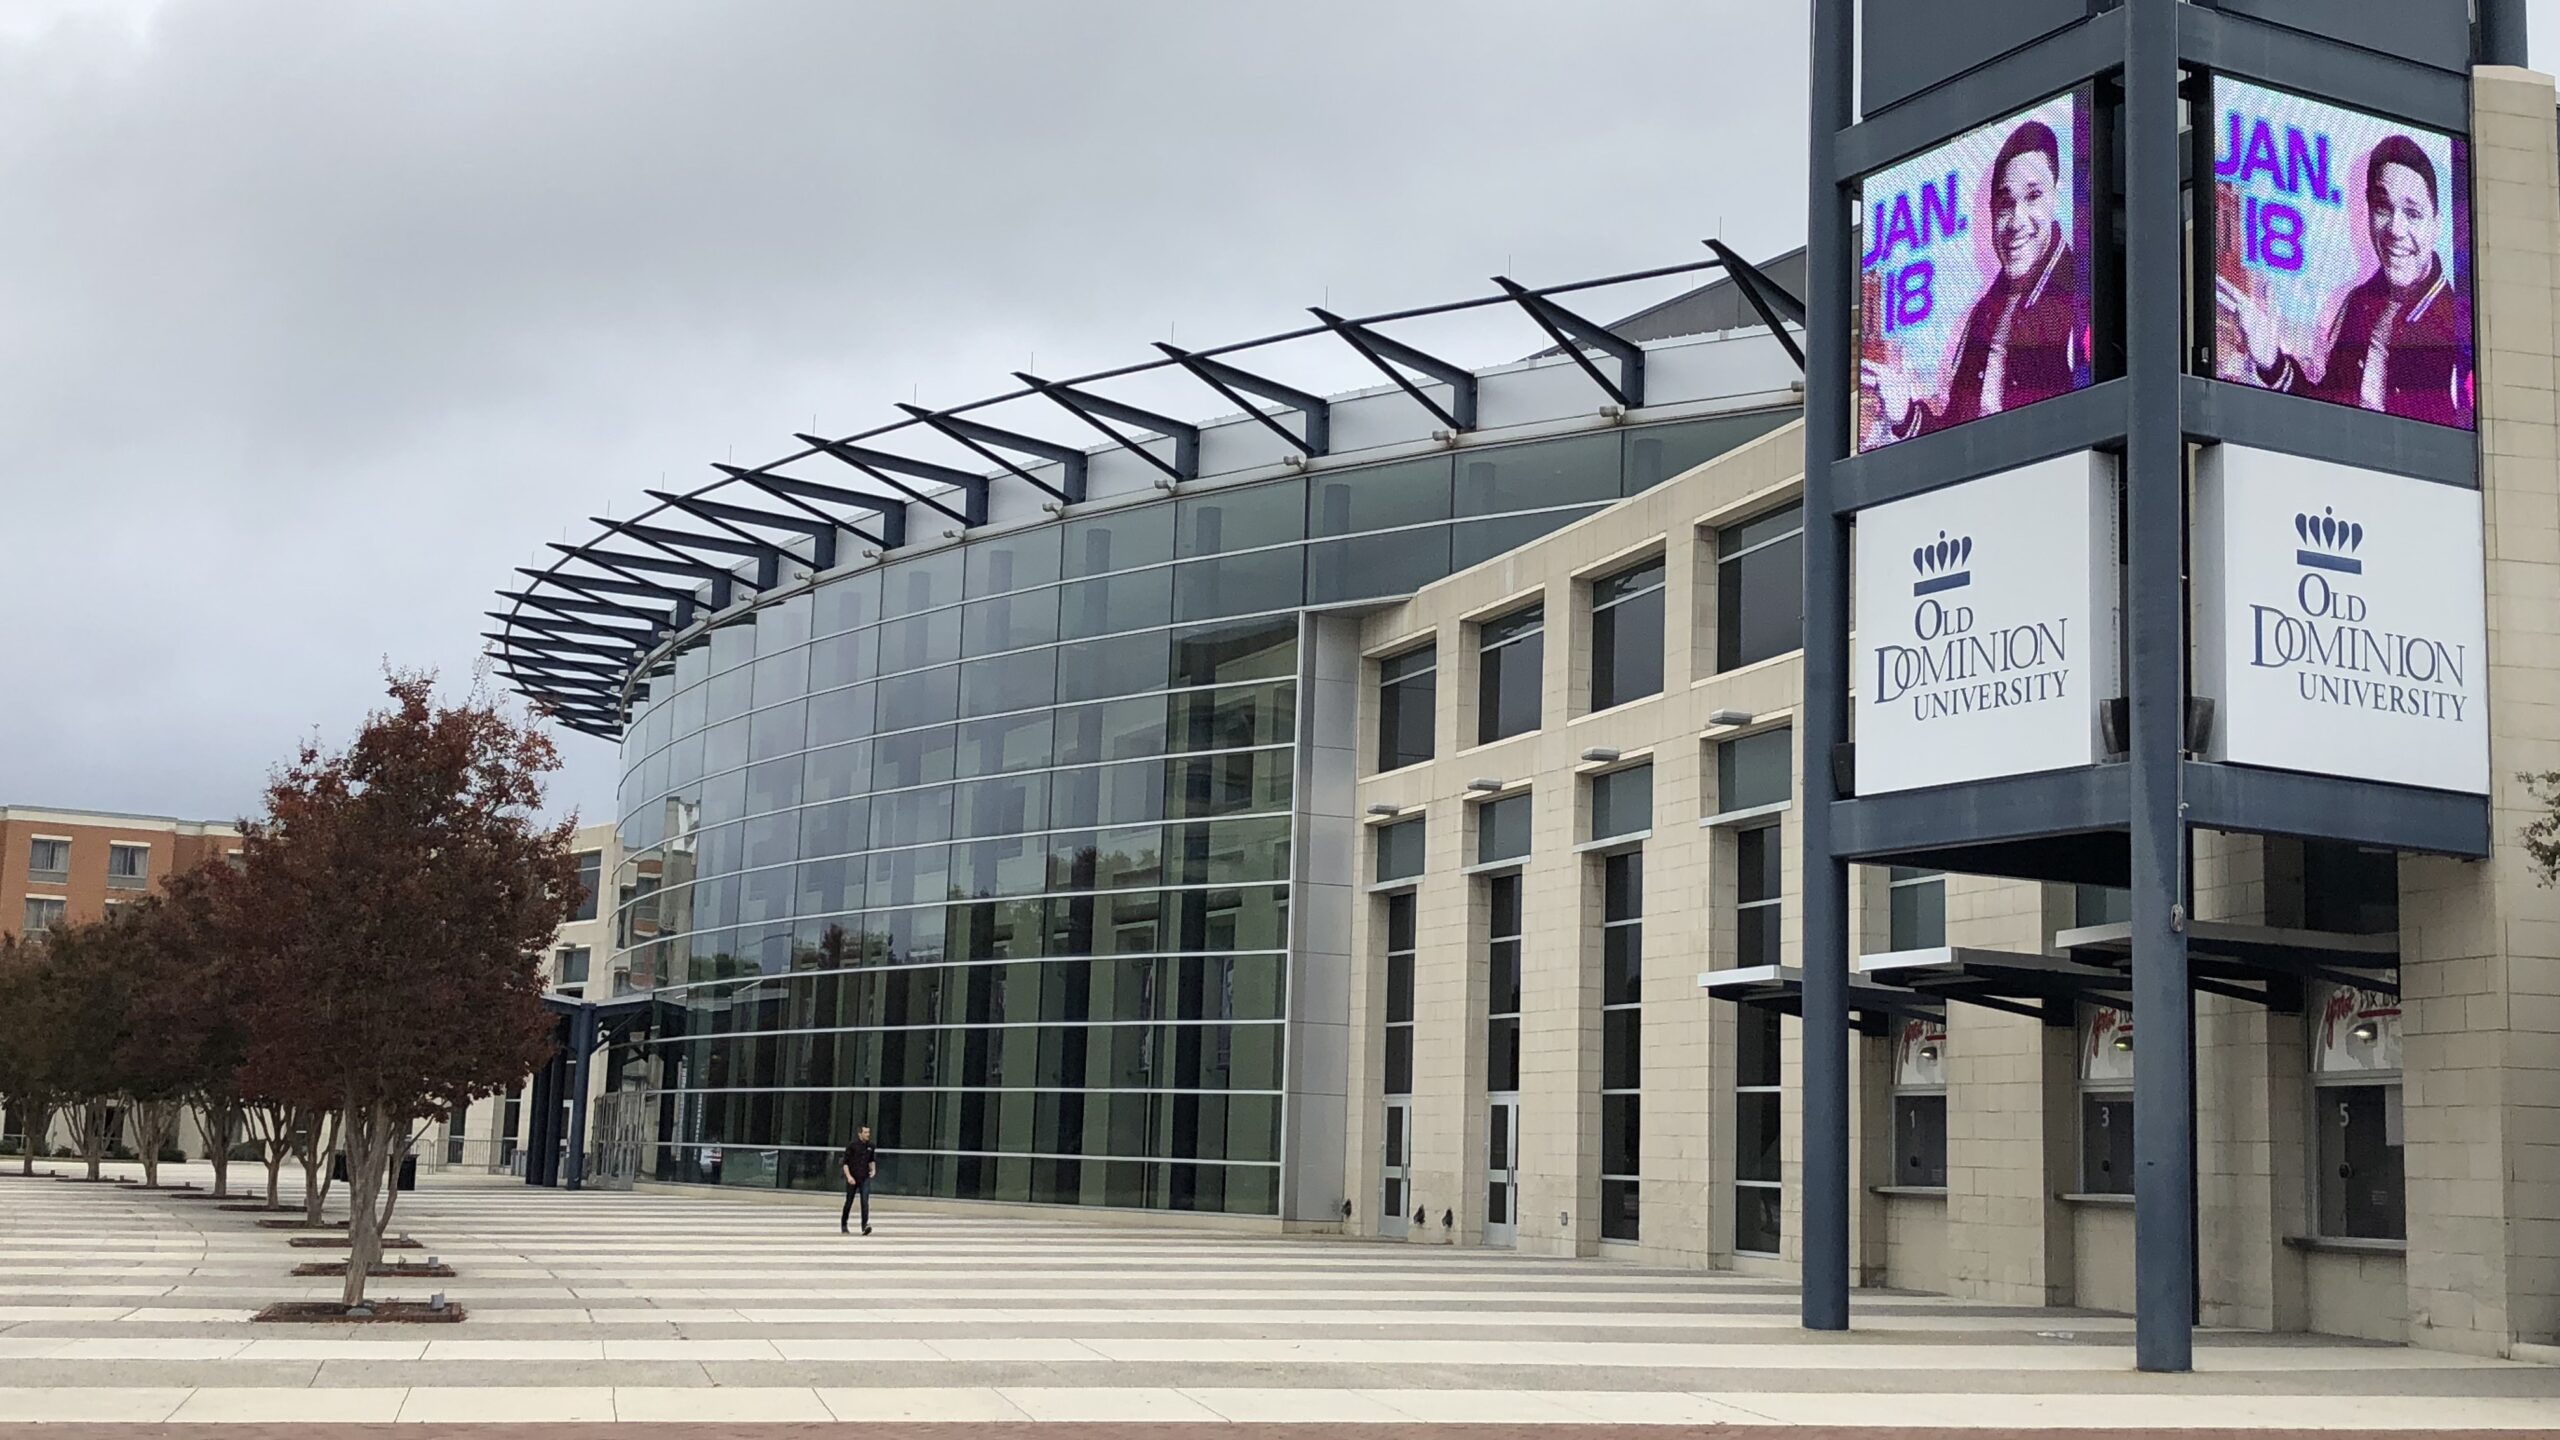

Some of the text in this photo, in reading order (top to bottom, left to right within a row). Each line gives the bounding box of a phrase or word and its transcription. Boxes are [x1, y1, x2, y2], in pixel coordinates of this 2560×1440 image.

[2214, 112, 2343, 204] JAN.
[1862, 172, 1968, 269] JAN.
[2247, 196, 2304, 272] 18
[1886, 259, 1935, 334] 18
[1914, 599, 1974, 641] OLD
[2298, 573, 2366, 622] OLD
[1874, 617, 2068, 704] DOMINION
[2249, 603, 2465, 688] DOMINION
[1913, 669, 2070, 721] UNIVERSITY
[2297, 671, 2468, 722] UNIVERSITY
[1909, 1109, 1916, 1129] 1
[2101, 1106, 2110, 1127] 3
[2339, 1102, 2350, 1128] 5
